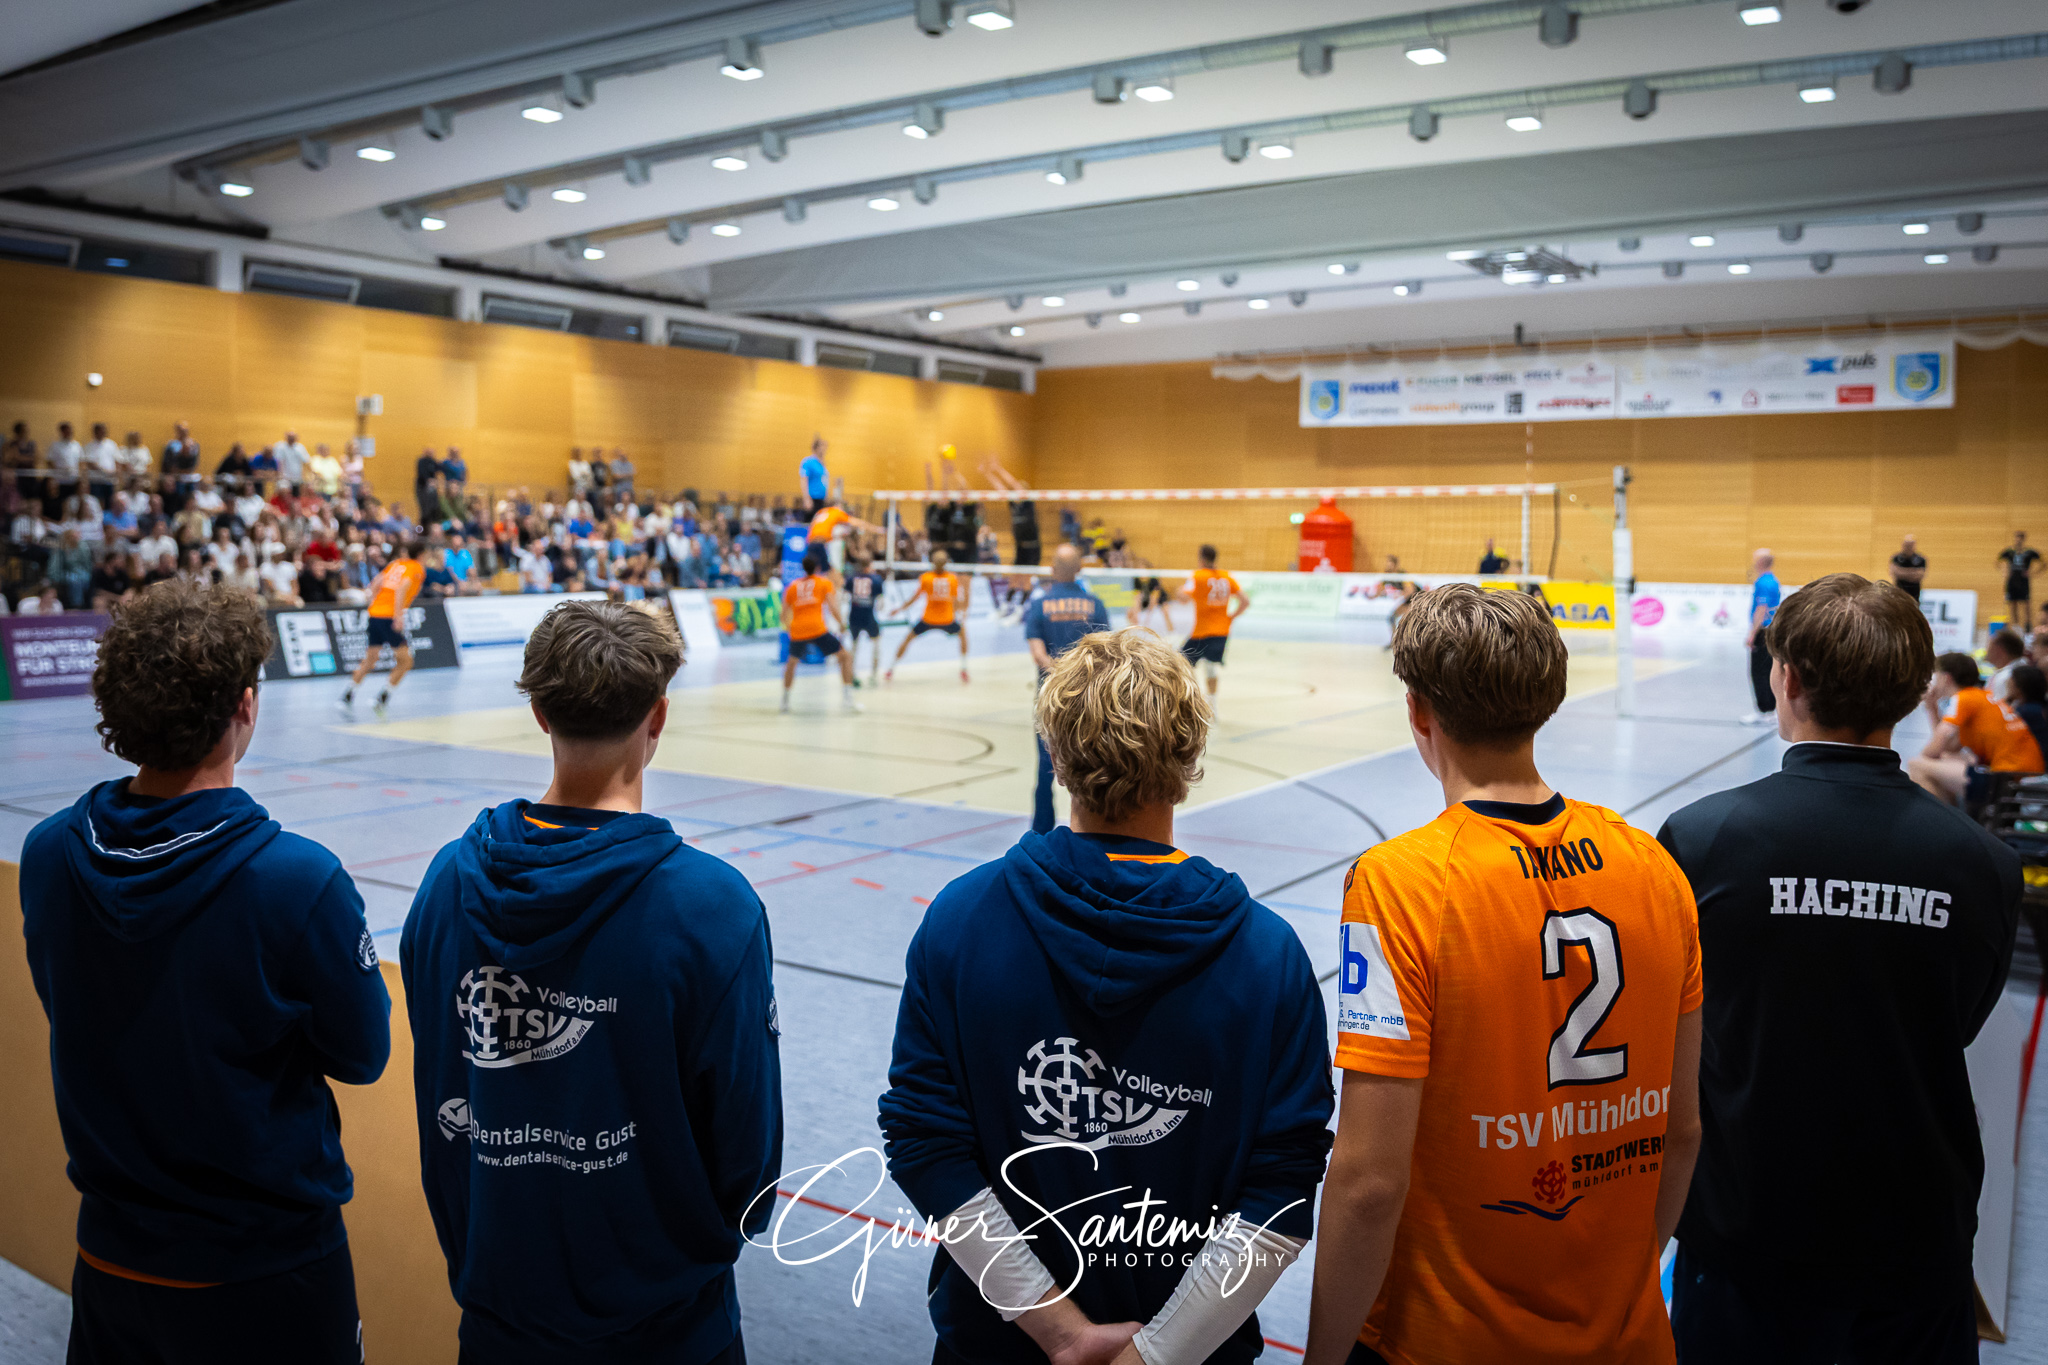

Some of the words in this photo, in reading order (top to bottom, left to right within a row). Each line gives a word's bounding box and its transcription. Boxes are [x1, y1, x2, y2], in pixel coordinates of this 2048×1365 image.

[1509, 837, 1604, 882] TAKANO
[1769, 877, 1952, 929] HACHING
[1339, 924, 1369, 995] b
[536, 985, 617, 1014] Volleyball
[1539, 906, 1628, 1092] 2
[503, 1008, 567, 1039] TSV
[1347, 1009, 1378, 1022] Partner
[1380, 1015, 1404, 1026] mbB
[504, 1040, 532, 1050] 1860
[531, 1038, 573, 1061] Mühldorf
[1112, 1066, 1213, 1107] Volleyball
[1081, 1086, 1153, 1124] TSV
[473, 1119, 586, 1151] Dentalservice
[595, 1121, 637, 1150] Gust
[1084, 1122, 1108, 1133] 1860
[1108, 1129, 1155, 1145] Mühldorf
[1155, 1128, 1167, 1137] a.
[1163, 1114, 1182, 1131] Inn
[1471, 1112, 1544, 1150] TSV
[1572, 1164, 1632, 1190] mühldorf
[1640, 1162, 1659, 1174] am
